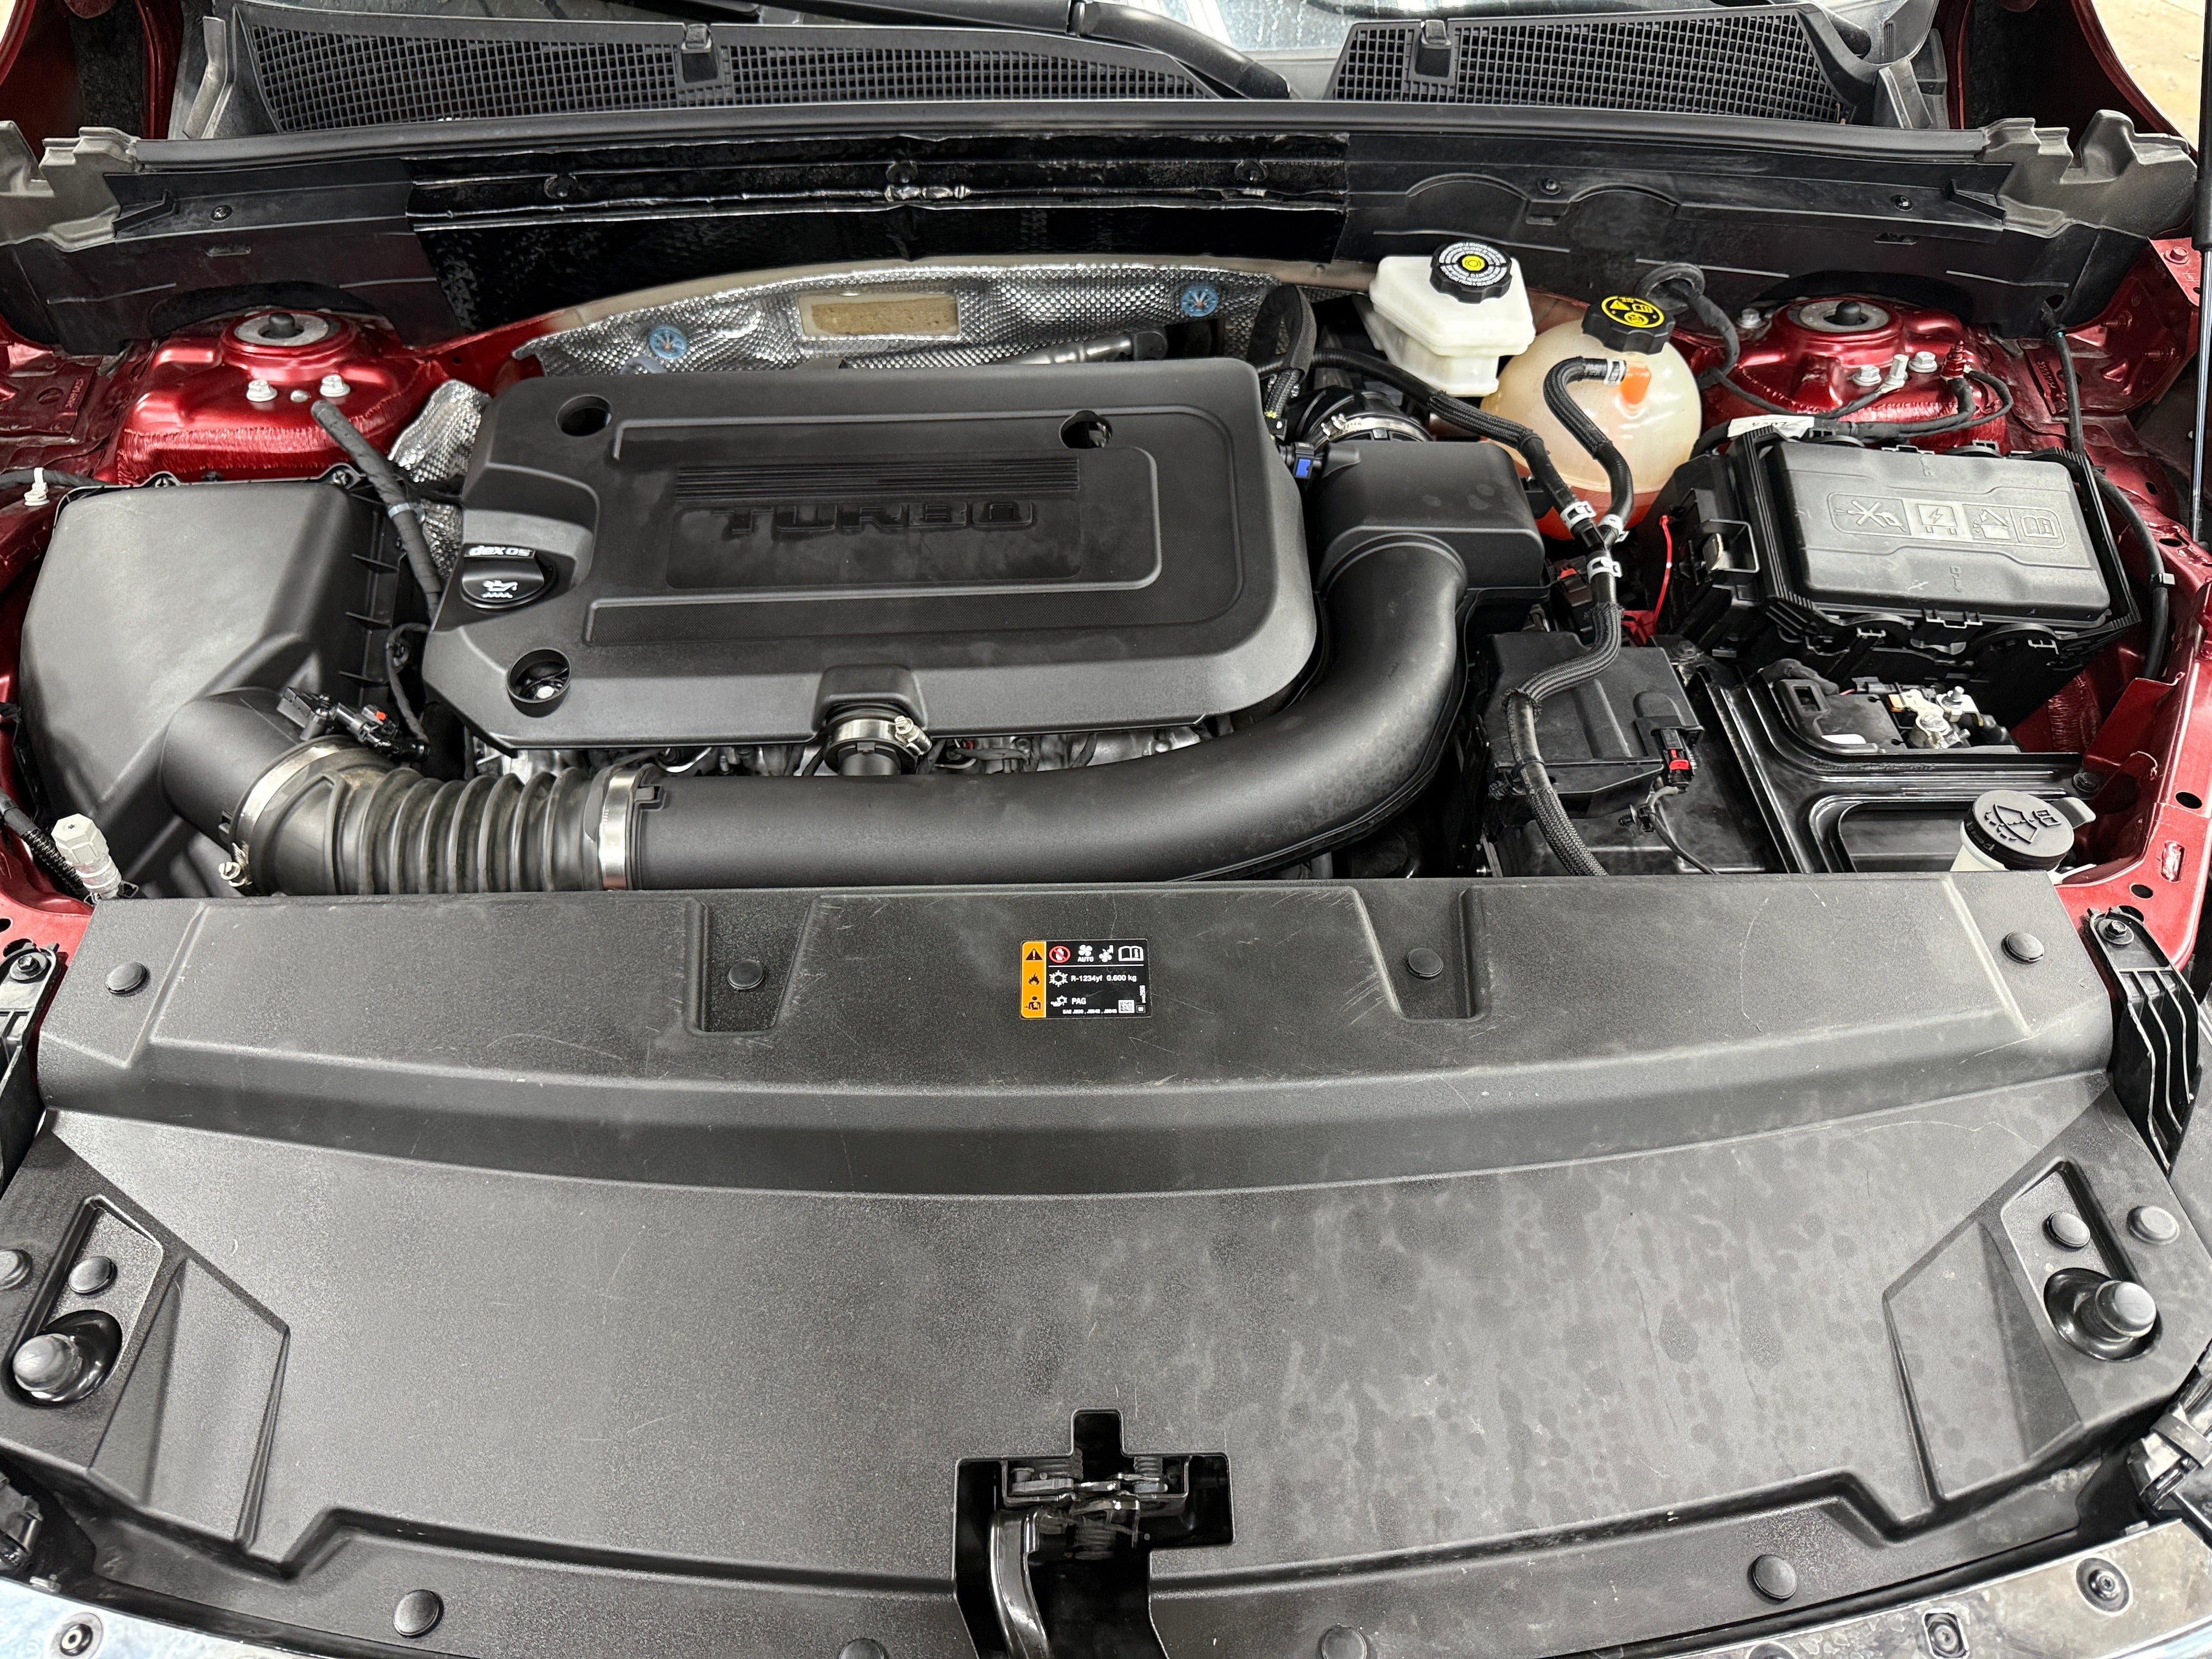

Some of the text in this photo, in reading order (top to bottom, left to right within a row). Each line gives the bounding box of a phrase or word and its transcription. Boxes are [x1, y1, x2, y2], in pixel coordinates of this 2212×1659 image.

[712, 500, 1034, 534] TURBO
[469, 545, 531, 557] dexos
[1070, 974, 1103, 983] R-1234yf
[1127, 974, 1137, 983] kg
